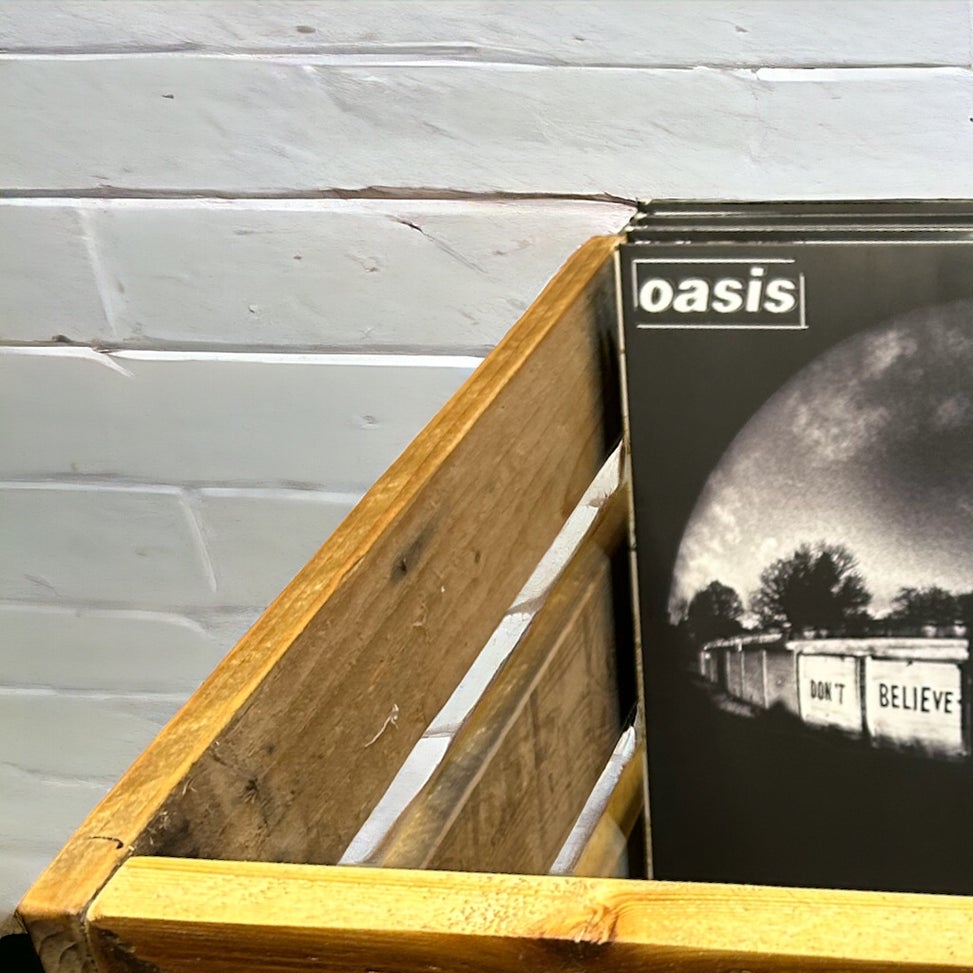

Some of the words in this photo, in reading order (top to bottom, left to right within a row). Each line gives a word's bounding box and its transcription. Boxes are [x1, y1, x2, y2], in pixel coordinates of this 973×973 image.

[639, 267, 797, 313] oasis
[810, 680, 846, 705] DON'T
[879, 683, 955, 714] BELIEVE
